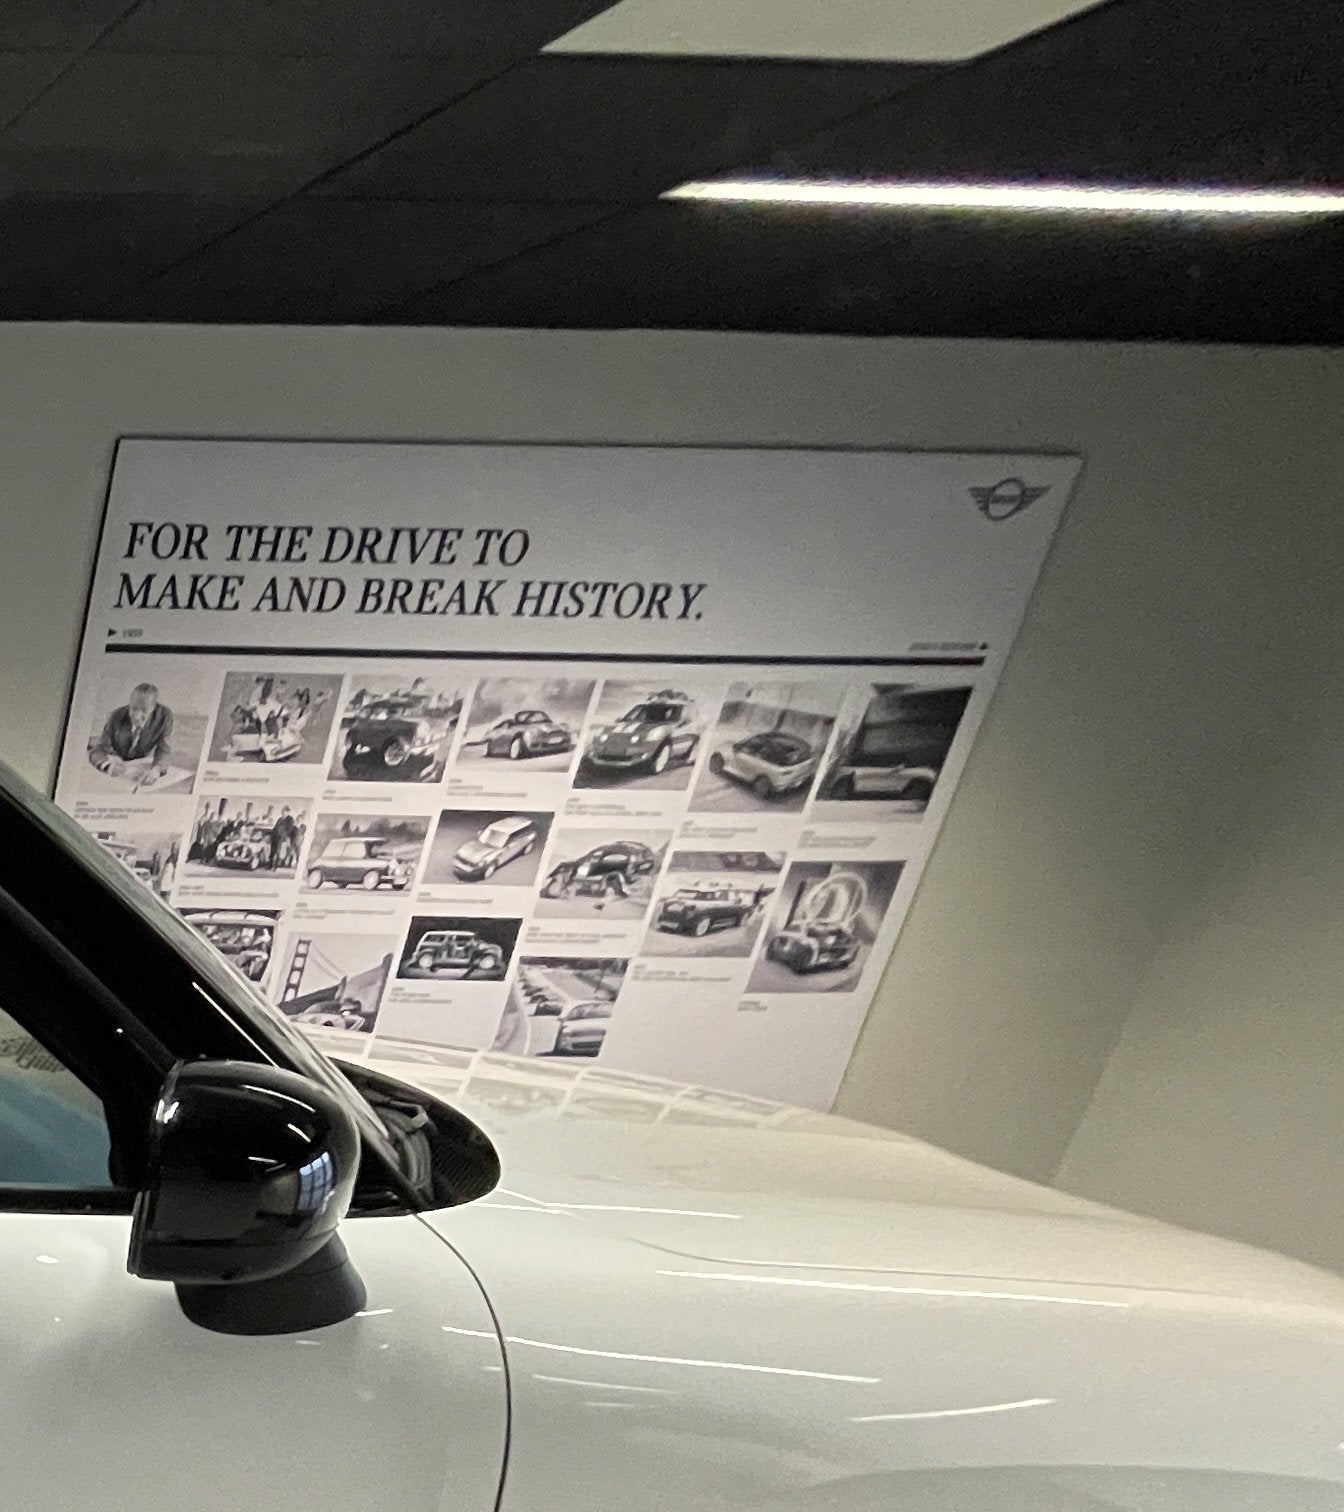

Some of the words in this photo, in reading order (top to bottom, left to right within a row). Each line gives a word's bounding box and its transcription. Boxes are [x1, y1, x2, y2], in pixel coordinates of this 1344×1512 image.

[122, 521, 210, 561] FOR
[225, 523, 314, 562] THE
[318, 525, 464, 565] DRIVE
[472, 528, 531, 567] TO
[112, 572, 246, 611] MAKE
[251, 575, 347, 614] AND
[354, 577, 508, 616] BREAK
[512, 580, 708, 620] HISTORY.
